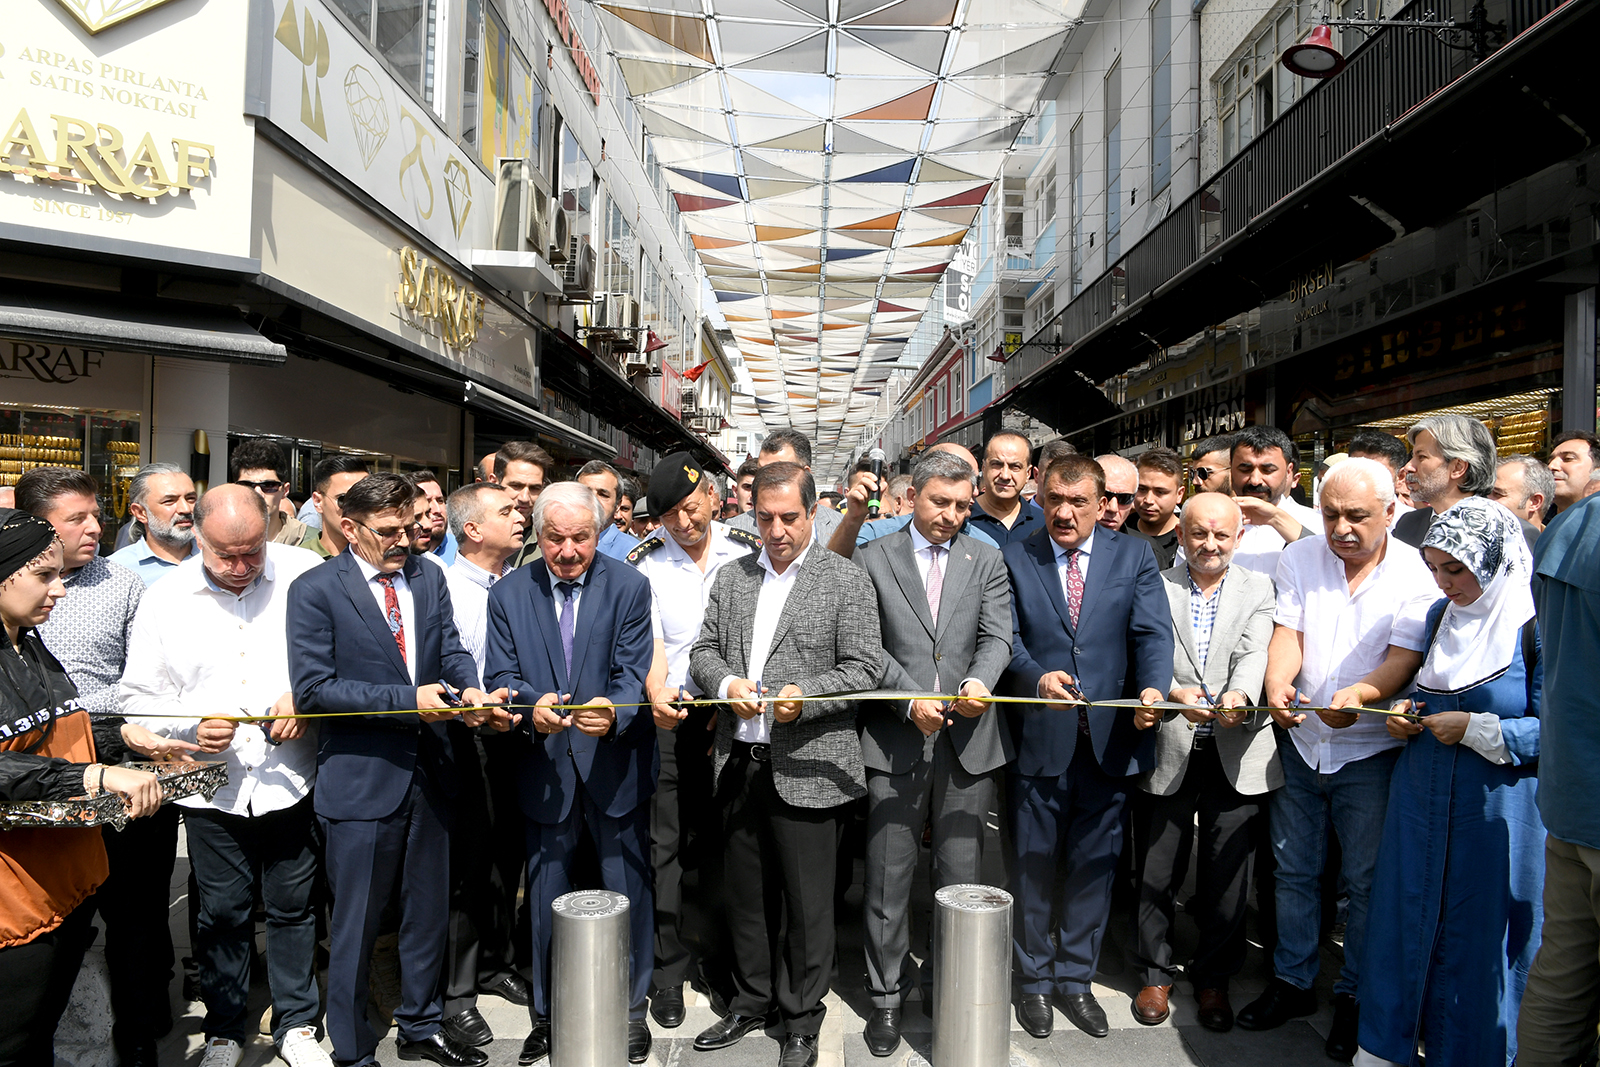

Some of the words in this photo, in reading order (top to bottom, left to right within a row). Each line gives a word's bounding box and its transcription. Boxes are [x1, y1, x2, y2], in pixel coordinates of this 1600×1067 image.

[18, 46, 94, 75] ARPAŞ
[99, 62, 209, 101] PIRLANTA
[30, 70, 95, 98] SATIŞ
[101, 84, 197, 119] NOKTASI
[32, 198, 91, 219] SINCE
[97, 208, 133, 225] 1957
